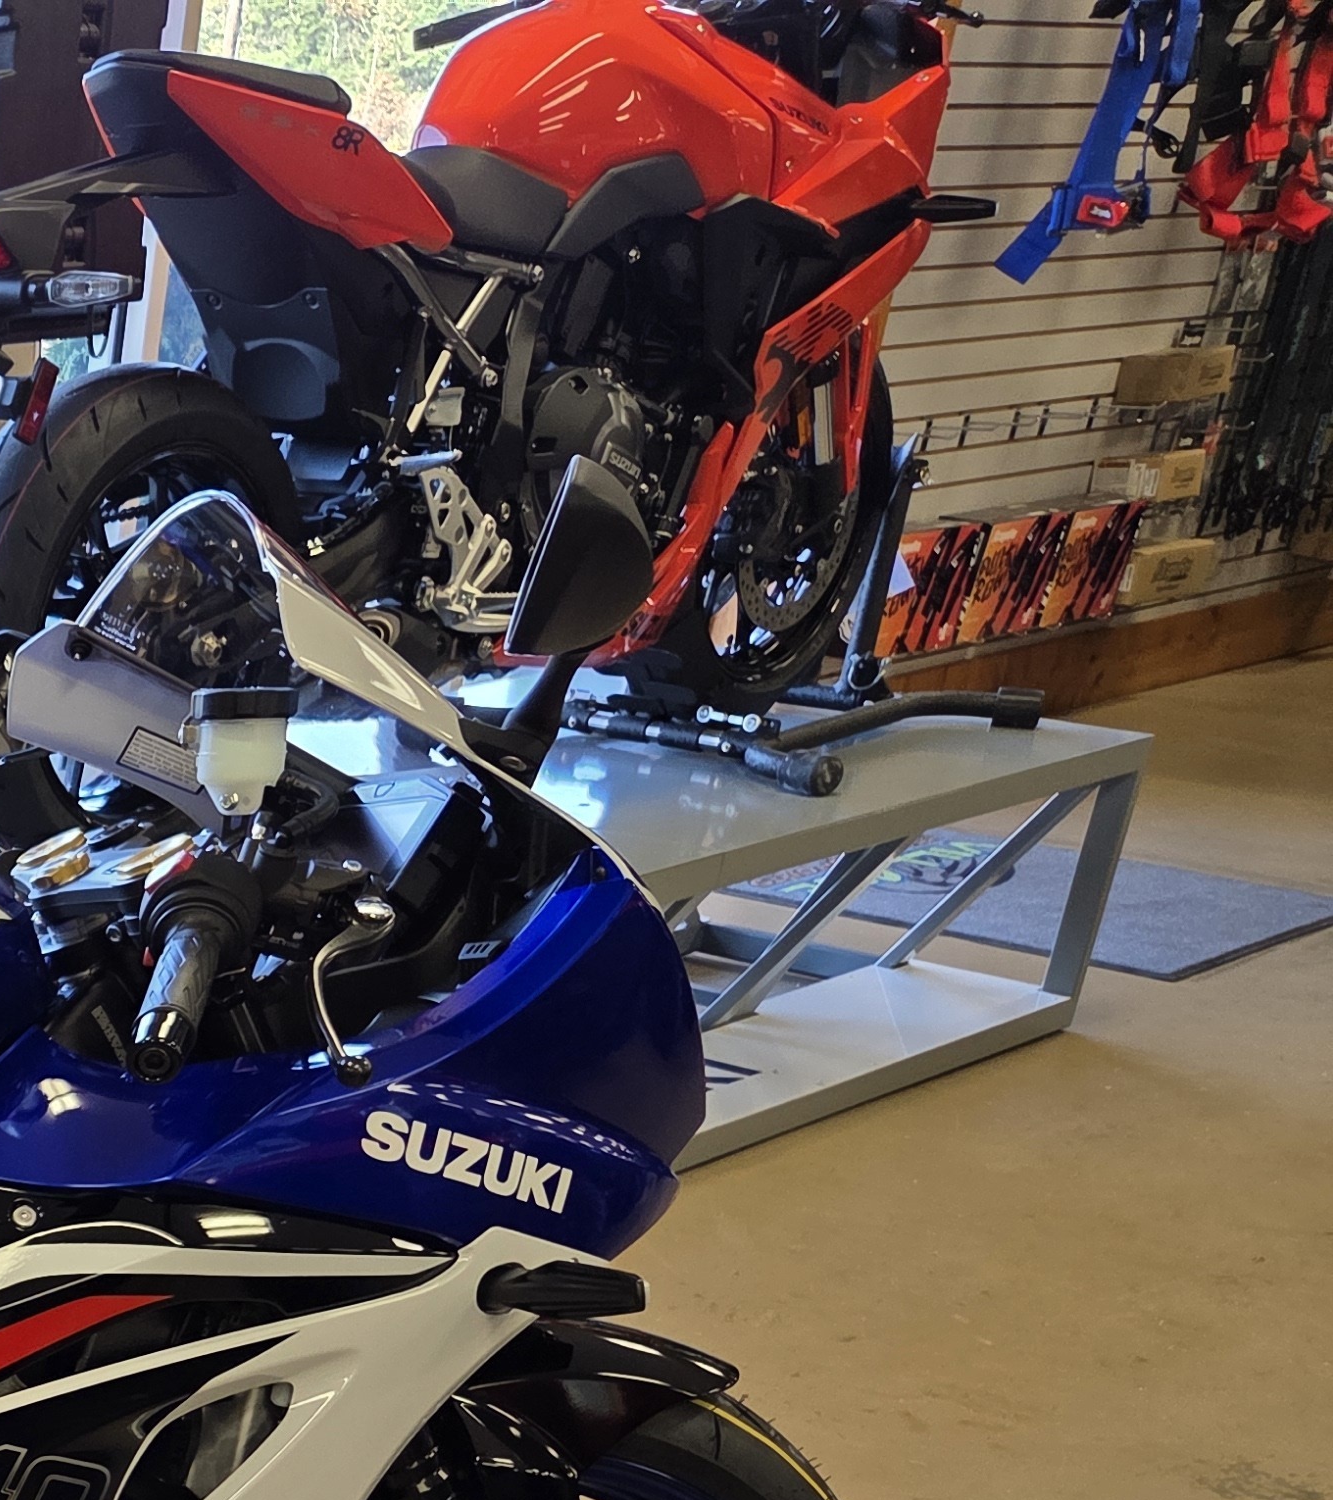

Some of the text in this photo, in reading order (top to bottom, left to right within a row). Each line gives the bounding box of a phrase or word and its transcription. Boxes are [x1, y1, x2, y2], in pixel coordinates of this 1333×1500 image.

[769, 97, 830, 135] SUZUKI
[331, 126, 366, 156] 8R
[361, 1110, 573, 1214] SUZUKI
